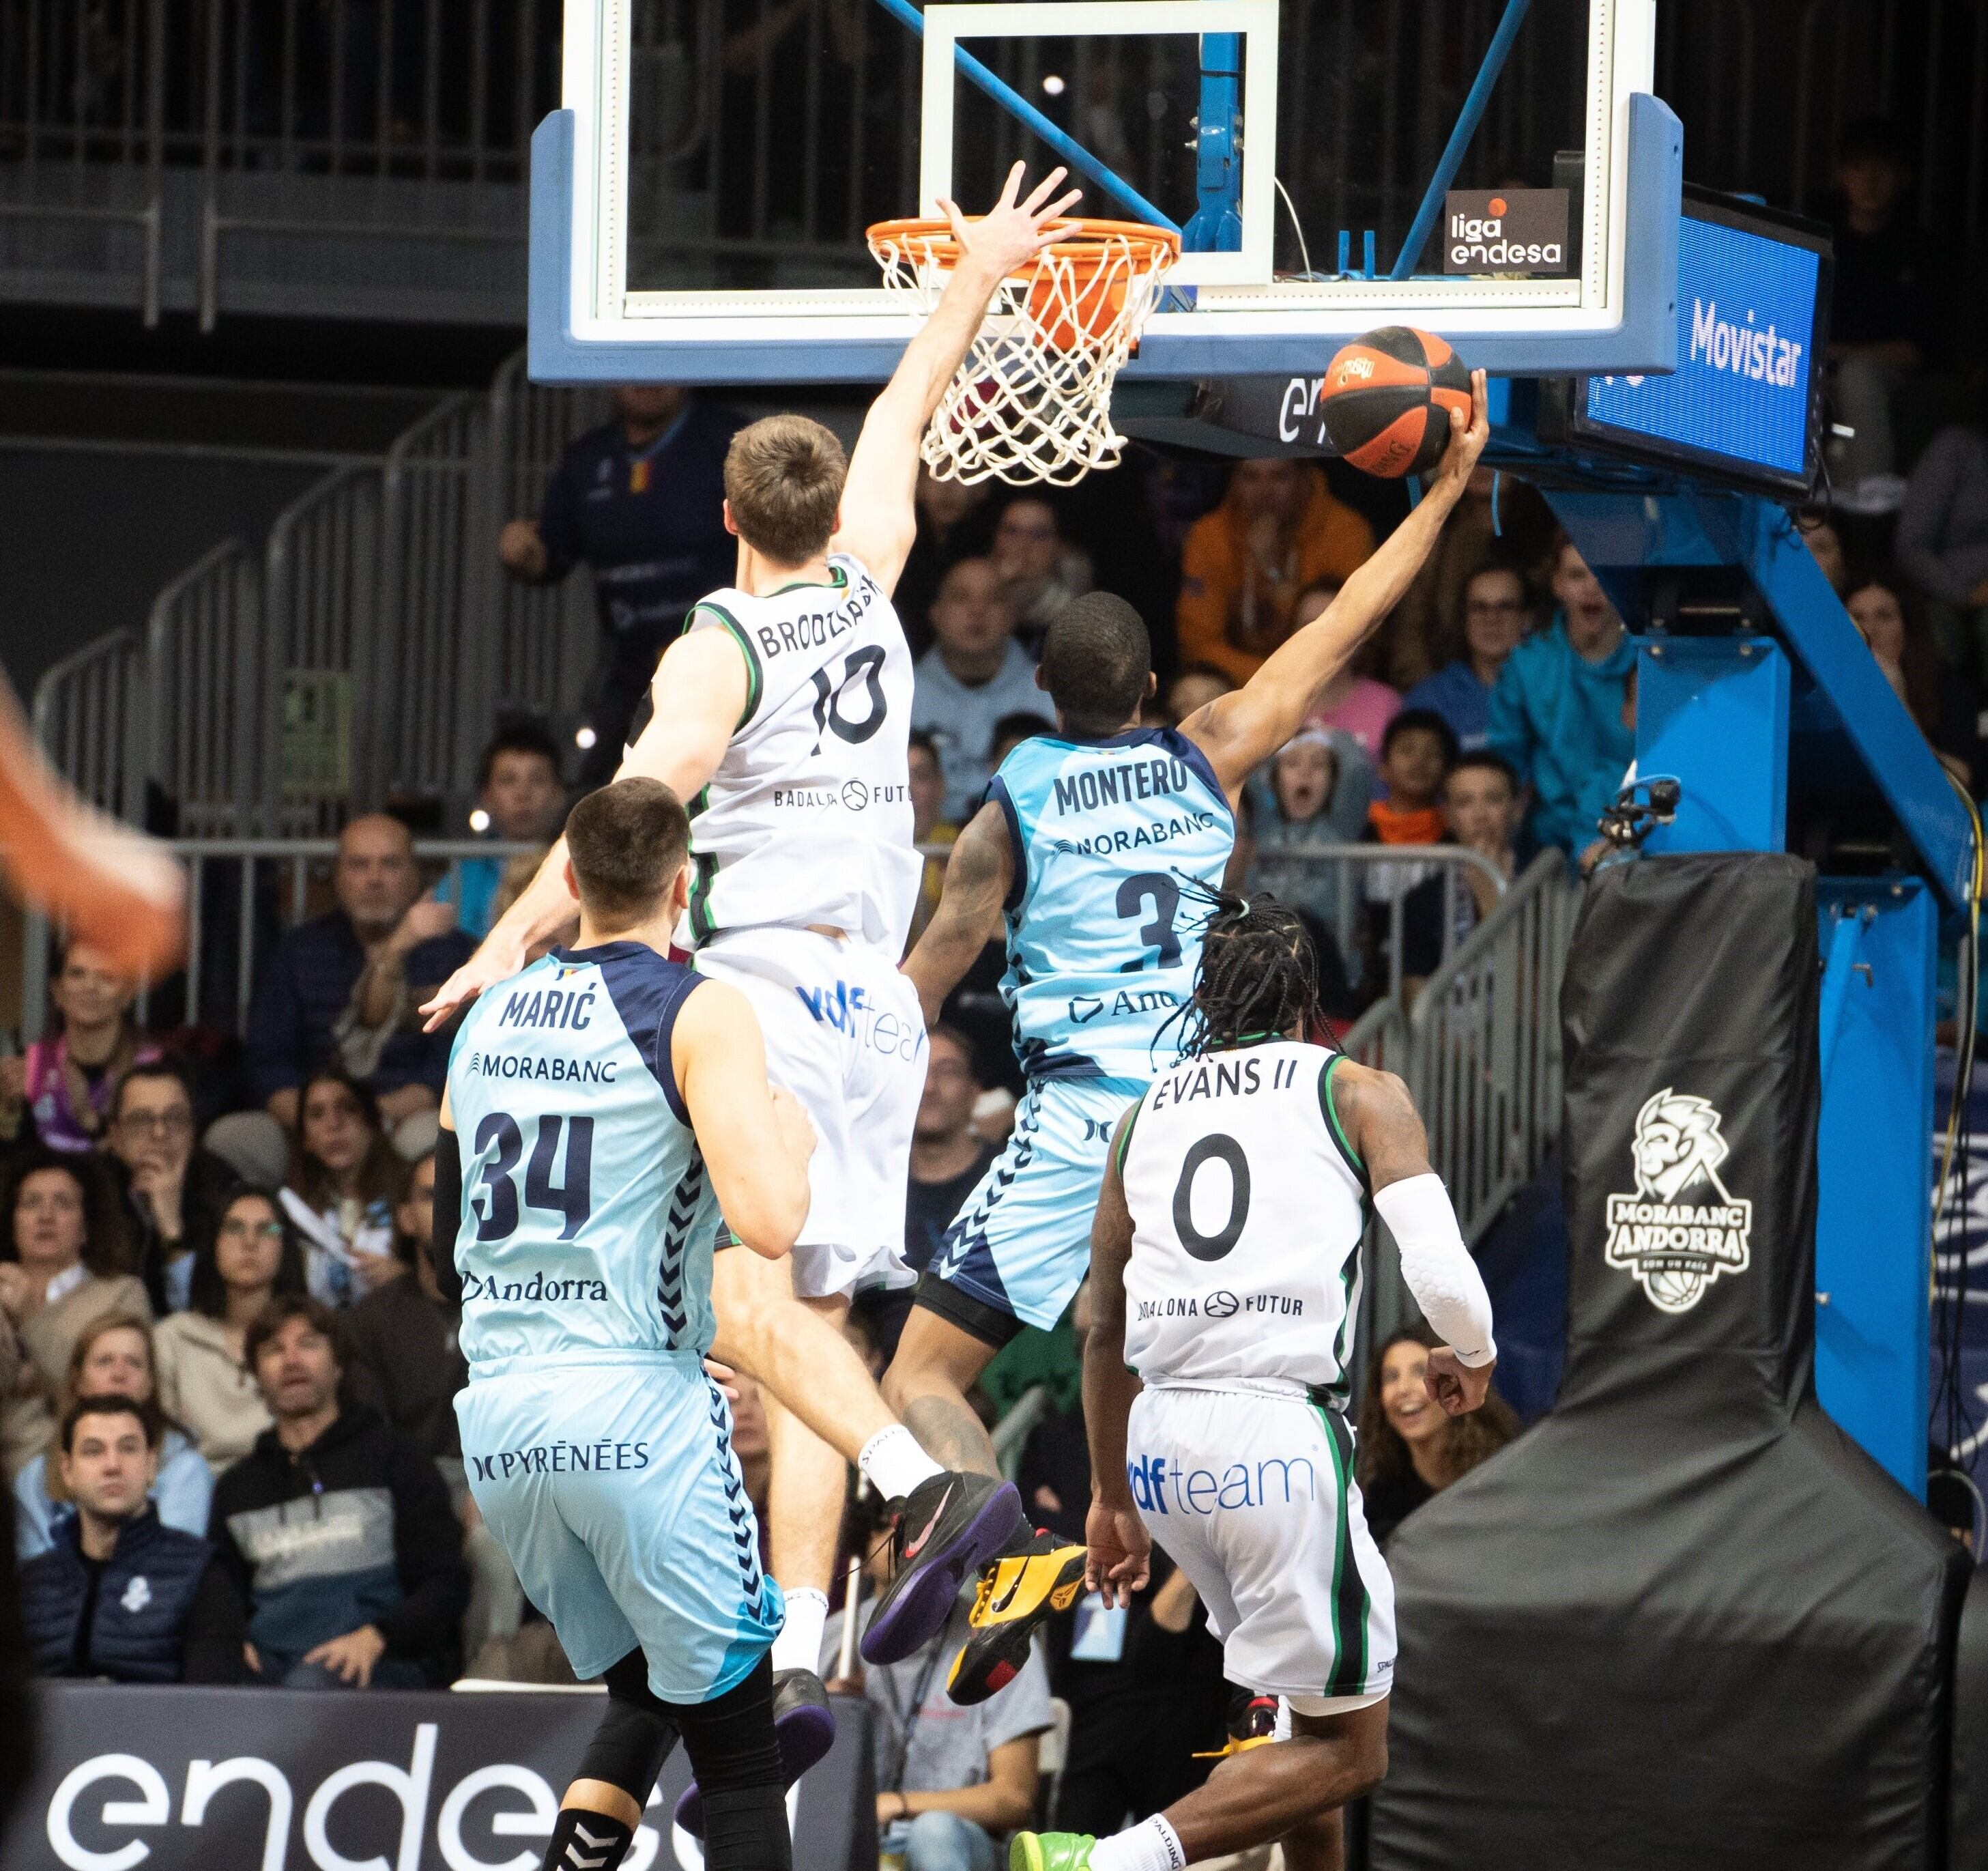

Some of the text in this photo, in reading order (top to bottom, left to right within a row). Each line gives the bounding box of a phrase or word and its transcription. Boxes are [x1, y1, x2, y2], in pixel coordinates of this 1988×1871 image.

[1451, 240, 1561, 264] endesa
[1452, 214, 1501, 242] liga
[1690, 297, 1802, 388] Movistar
[809, 644, 887, 757] 10
[1053, 756, 1188, 816] MONTERO
[1115, 872, 1183, 974] 3
[498, 982, 597, 1031] MARIĆ
[482, 1054, 618, 1083] MORABANC
[1153, 1058, 1261, 1111] EVANS
[470, 1112, 594, 1242] 34
[1172, 1133, 1251, 1262] 0
[1615, 1202, 1743, 1228] MORABANC
[1613, 1224, 1741, 1261] ANDORRA
[482, 1271, 608, 1302] Andorra
[1245, 1294, 1303, 1316] FUTUR
